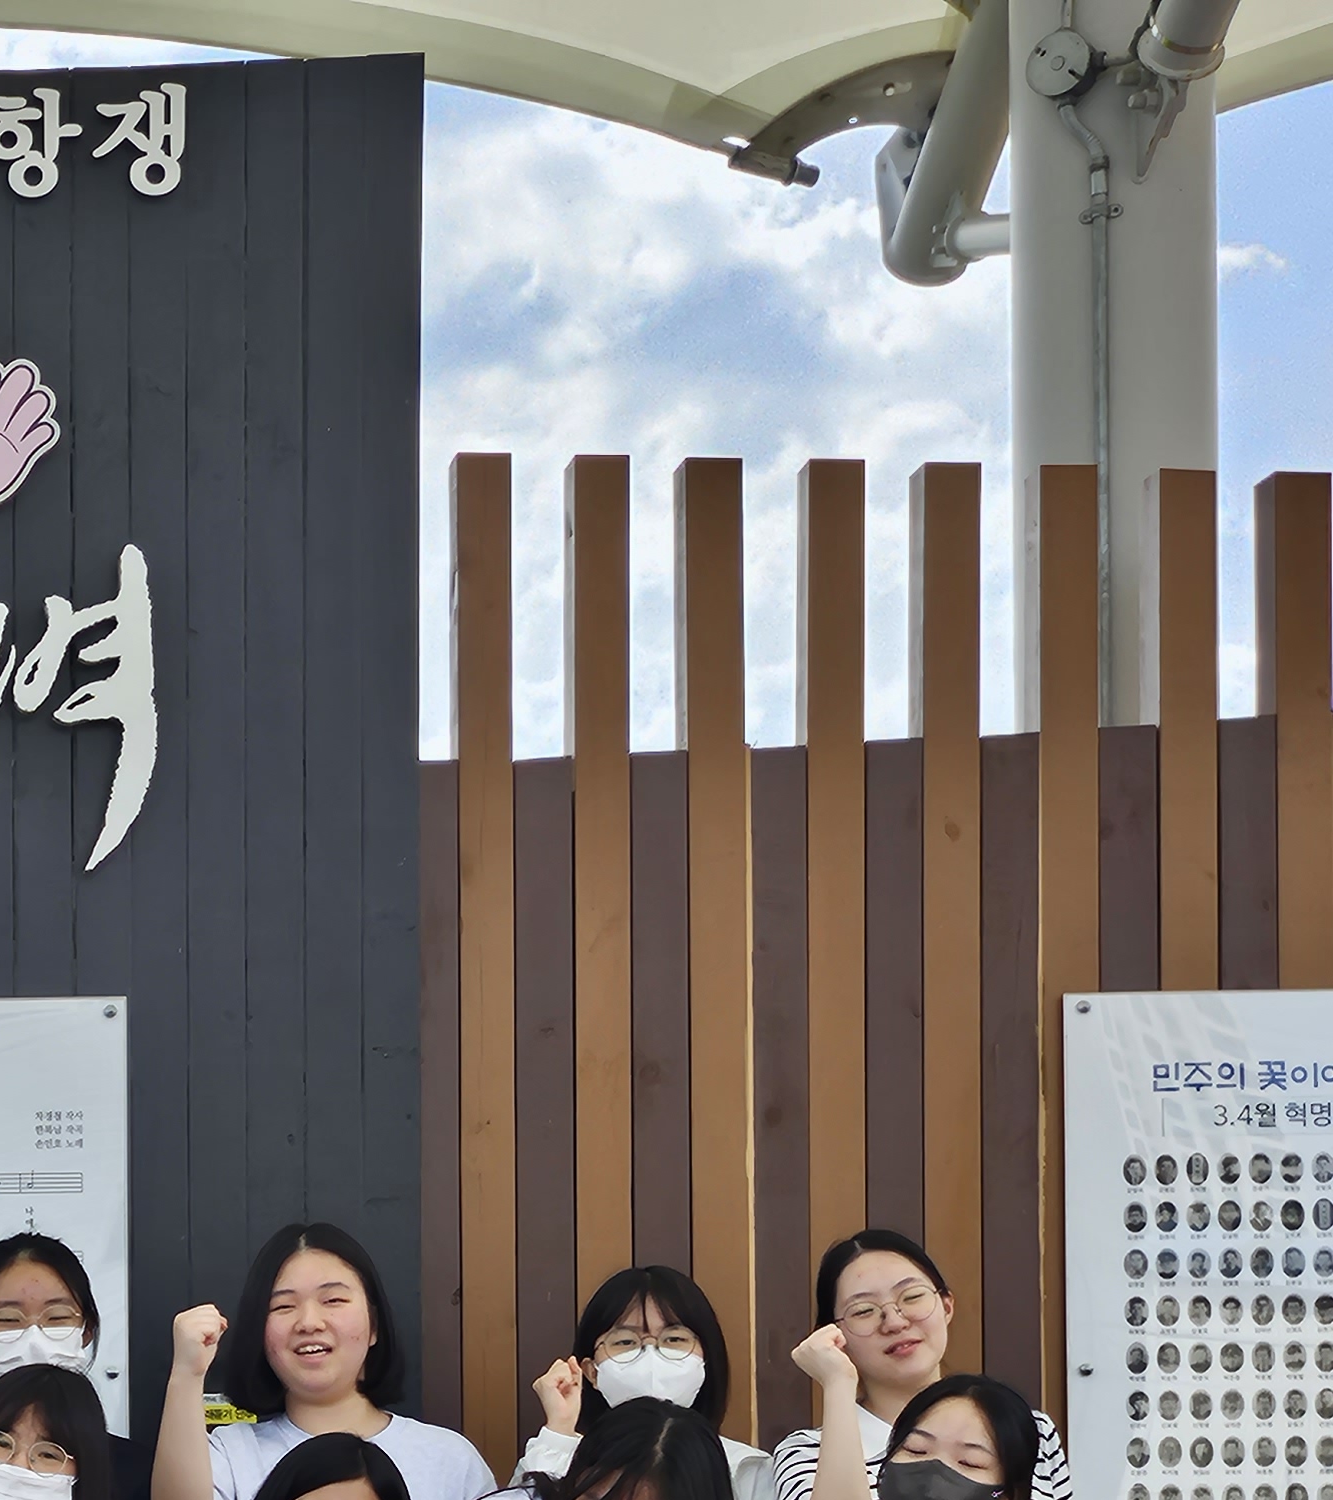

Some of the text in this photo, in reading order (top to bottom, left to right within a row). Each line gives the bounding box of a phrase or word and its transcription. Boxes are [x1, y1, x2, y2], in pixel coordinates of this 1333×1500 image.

[1152, 1061, 1245, 1092] 민주의
[1213, 1102, 1333, 1128] 3.4월 혁명
